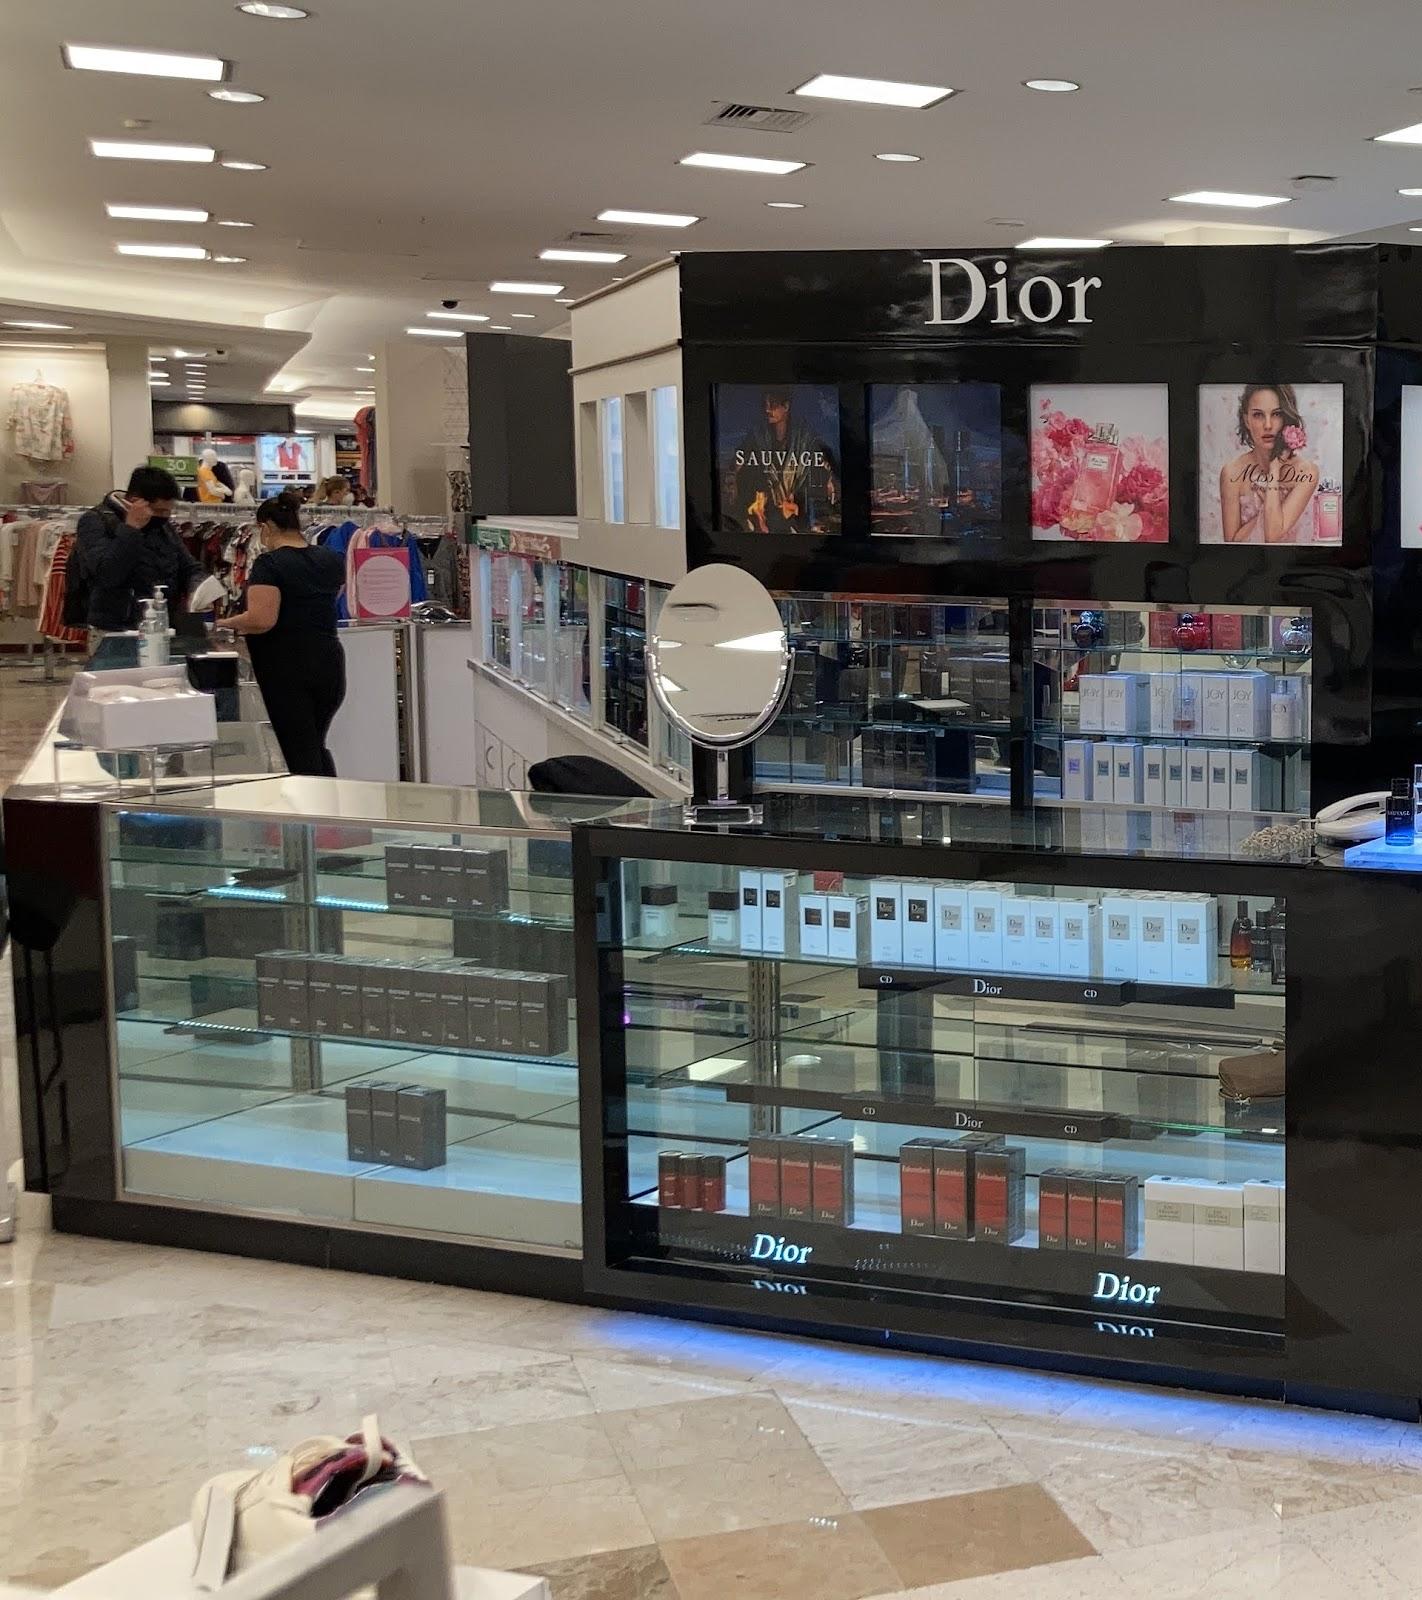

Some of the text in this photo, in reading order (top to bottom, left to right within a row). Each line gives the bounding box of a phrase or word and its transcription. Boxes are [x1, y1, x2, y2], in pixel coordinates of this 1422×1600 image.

[922, 258, 1102, 325] Dior
[735, 450, 825, 467] SAUVAGE
[1230, 463, 1313, 483] Miss Dior
[879, 975, 1097, 998] CD Dior CD
[862, 1106, 1078, 1134] CD Dior CD
[750, 1233, 813, 1264] Dior
[1093, 1272, 1161, 1304] Dior
